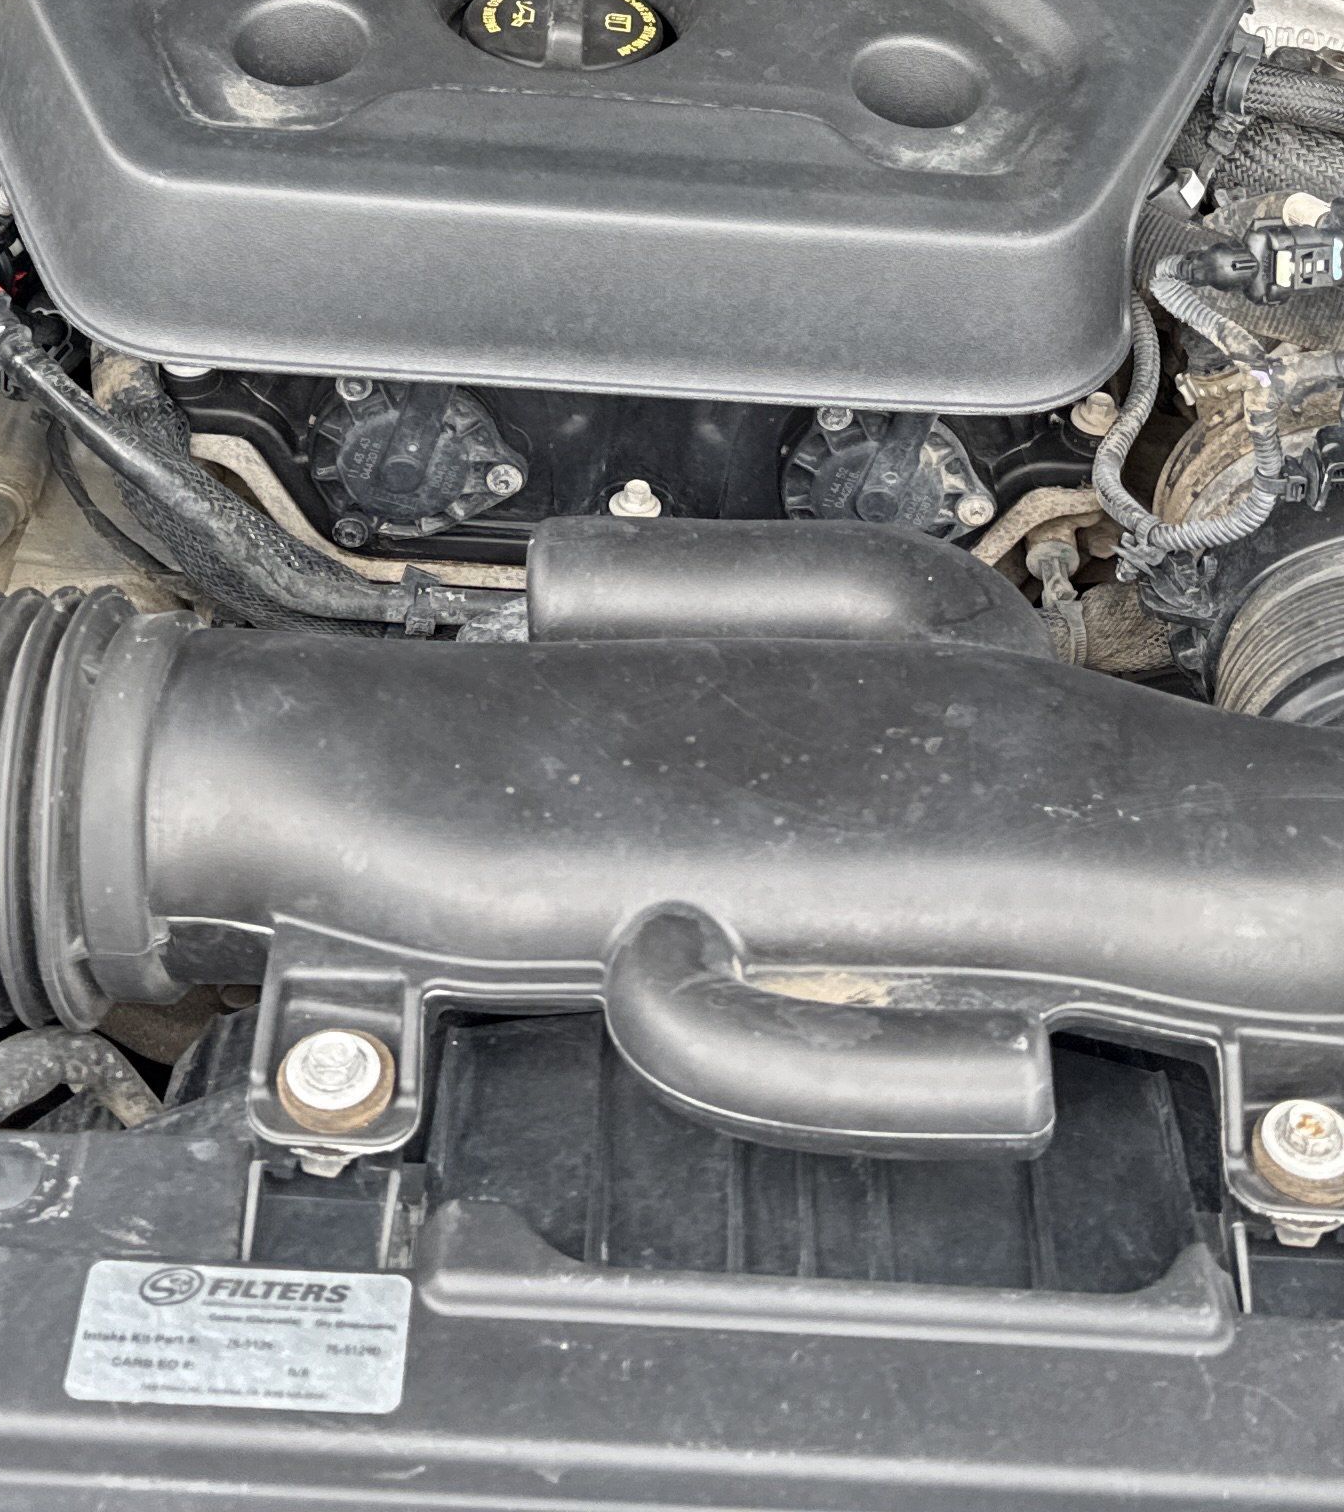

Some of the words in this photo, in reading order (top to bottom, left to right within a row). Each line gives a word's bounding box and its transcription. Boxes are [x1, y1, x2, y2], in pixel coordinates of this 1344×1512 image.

[208, 1277, 352, 1304] FILTERS
[83, 1329, 127, 1341] Intake
[155, 1333, 184, 1345] Part
[111, 1355, 153, 1369] CARB
